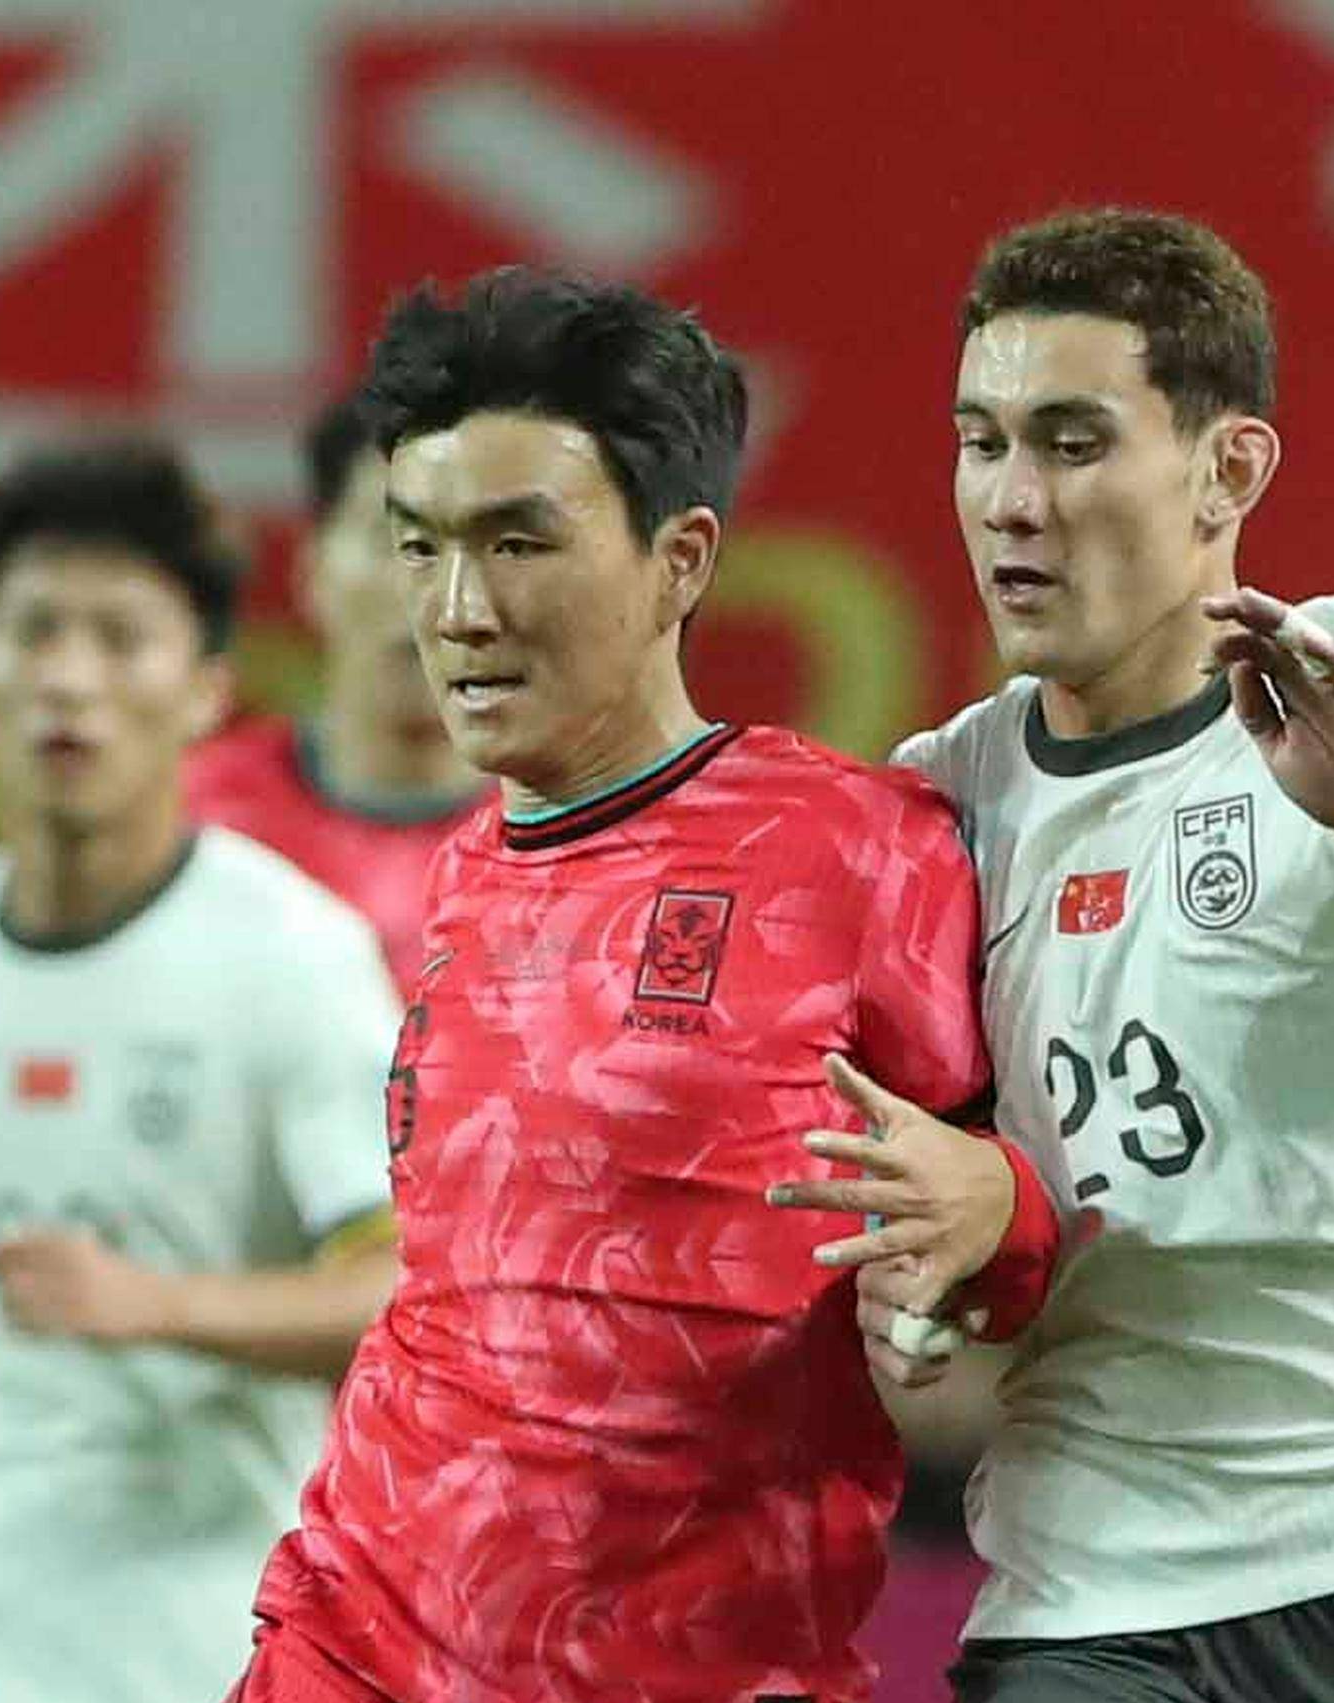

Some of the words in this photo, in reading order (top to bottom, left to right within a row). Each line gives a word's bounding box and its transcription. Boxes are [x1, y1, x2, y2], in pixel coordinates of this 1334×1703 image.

[1182, 803, 1245, 837] CFA
[622, 1007, 709, 1036] KOREA
[1044, 1018, 1205, 1201] 23
